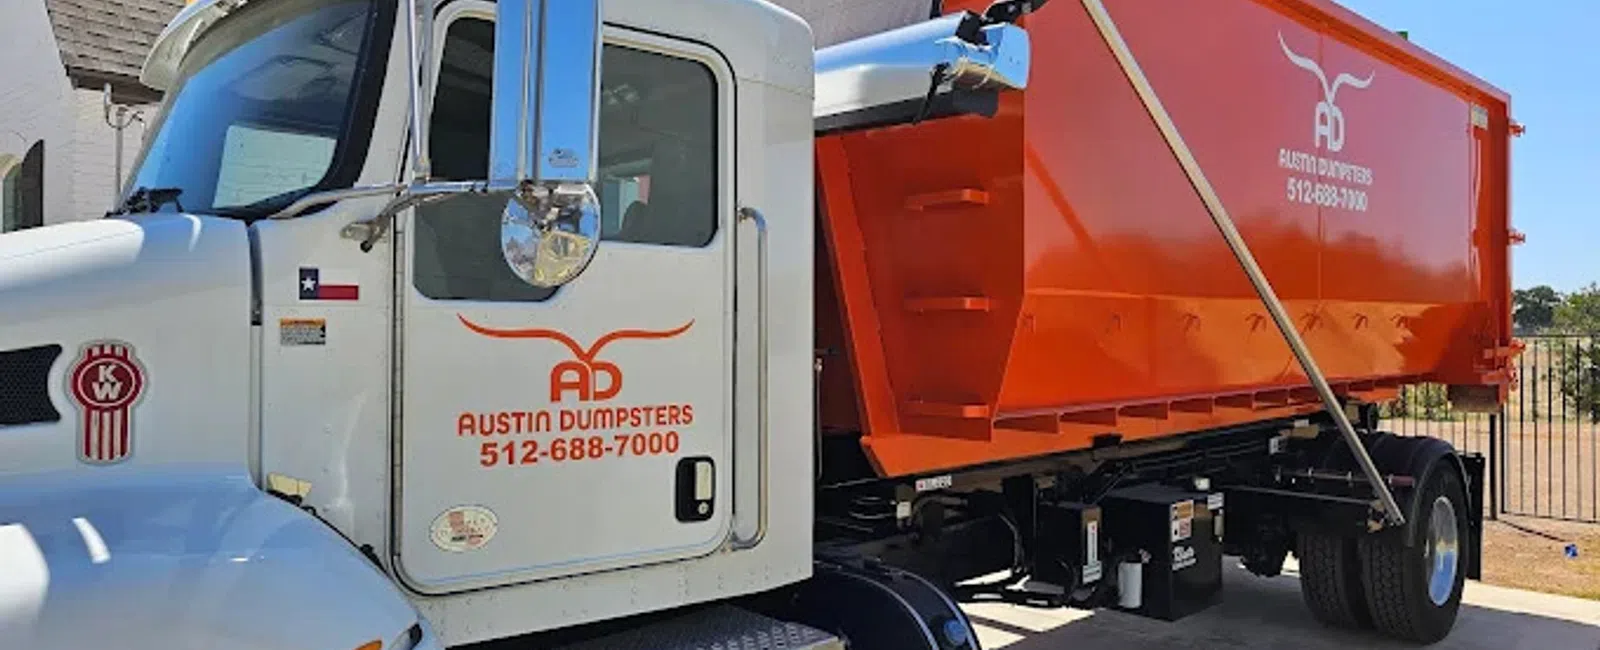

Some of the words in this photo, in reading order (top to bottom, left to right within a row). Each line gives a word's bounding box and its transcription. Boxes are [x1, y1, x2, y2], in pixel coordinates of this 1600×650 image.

[1315, 101, 1345, 152] AD
[1279, 148, 1317, 175] AUSTIN
[1318, 157, 1373, 186] DUMPSTERS
[1287, 177, 1369, 212] 512-688-7000
[550, 360, 623, 402] AD
[457, 411, 551, 436] AUSTIN
[559, 404, 694, 431] DUMPSTERS
[480, 431, 680, 467] 512-688-7000
